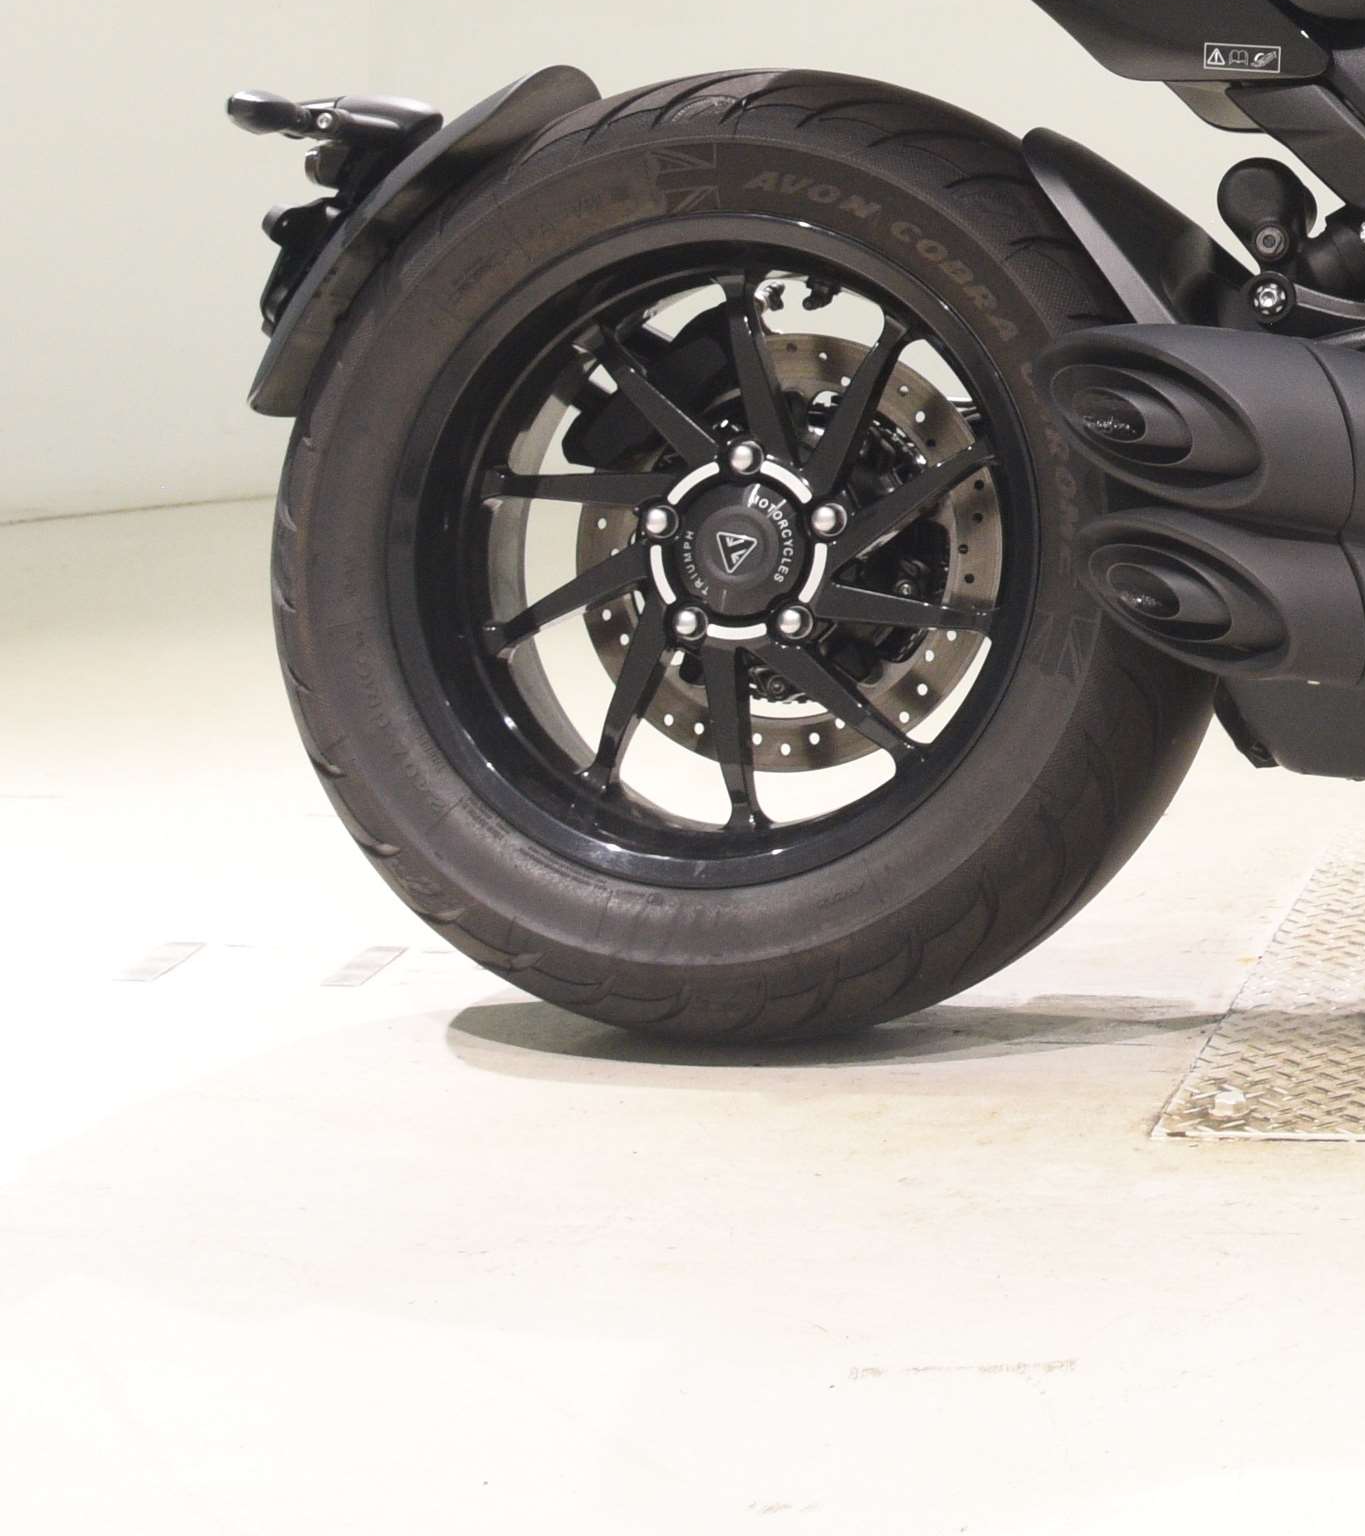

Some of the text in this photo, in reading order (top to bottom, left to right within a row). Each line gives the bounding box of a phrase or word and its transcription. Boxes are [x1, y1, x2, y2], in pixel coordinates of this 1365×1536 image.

[743, 169, 884, 219] AVON
[890, 220, 1020, 344] COBRA
[683, 490, 795, 596] TRIUMPH MOTORCYCLES
